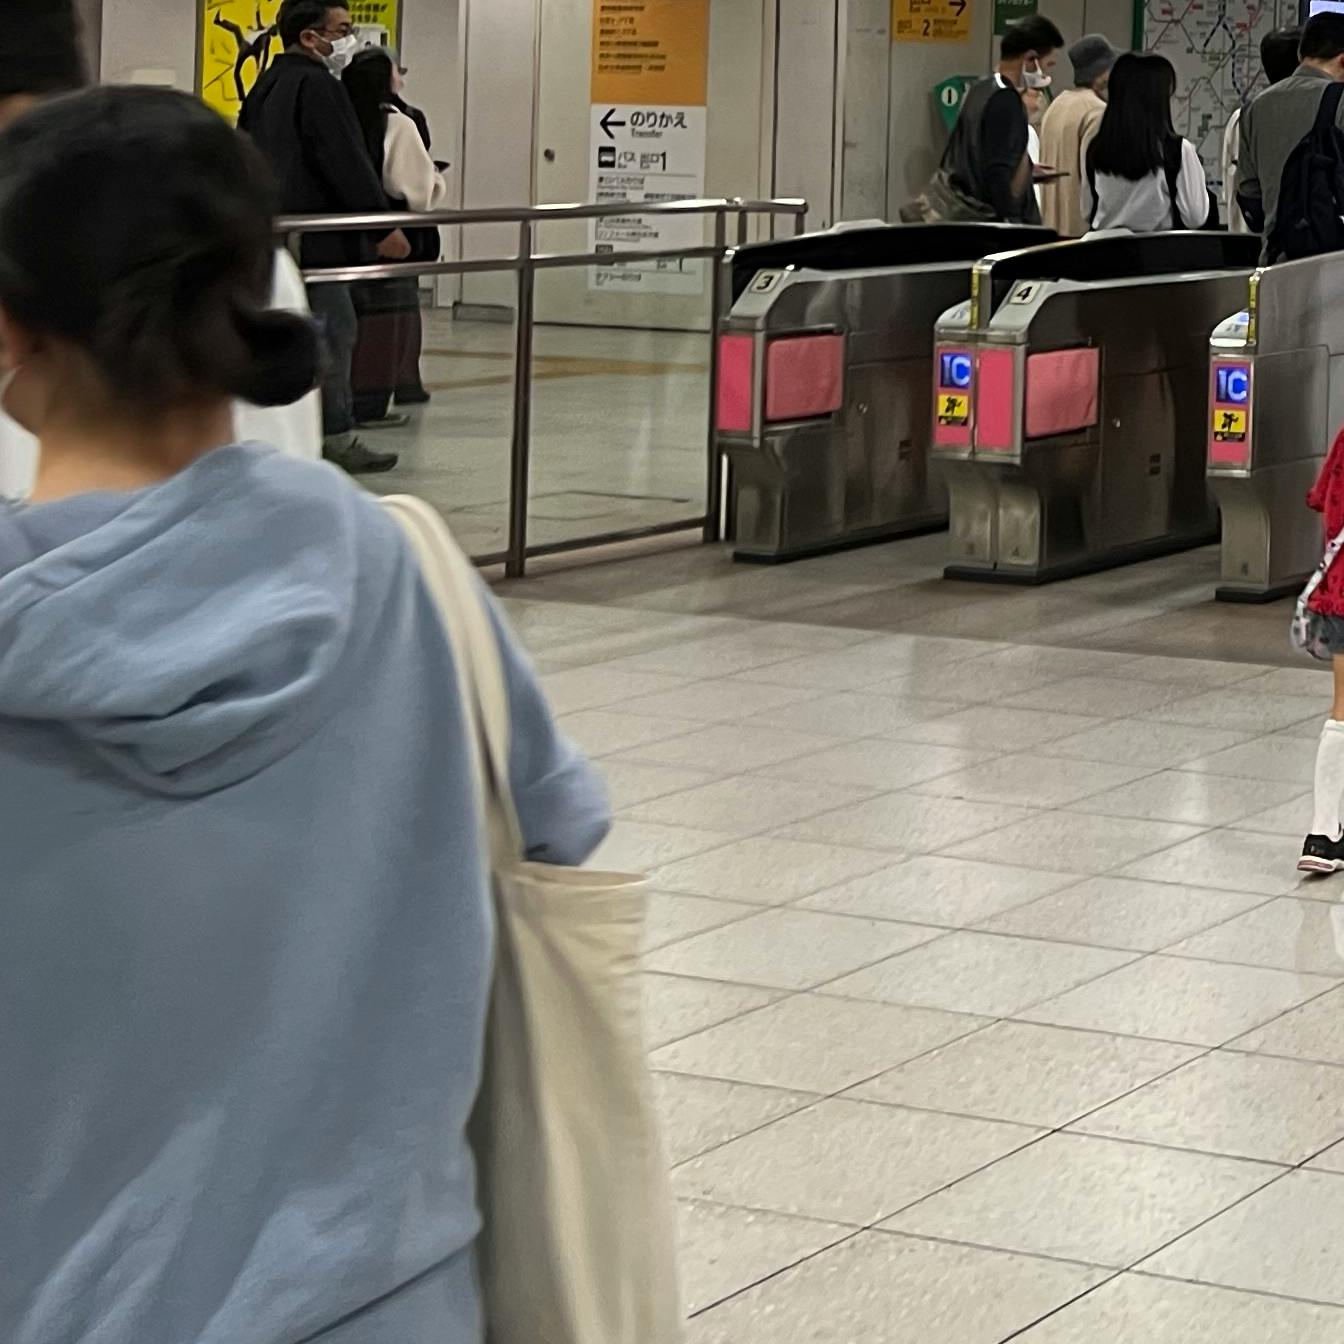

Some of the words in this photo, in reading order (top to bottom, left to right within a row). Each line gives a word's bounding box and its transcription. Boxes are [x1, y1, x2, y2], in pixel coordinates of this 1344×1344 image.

[922, 18, 931, 37] 2
[630, 110, 688, 129] のりかえ
[618, 151, 636, 162] バス
[660, 151, 667, 172] 1
[756, 275, 775, 291] 3
[1016, 285, 1033, 301] 4
[942, 354, 971, 387] IC
[1218, 369, 1248, 401] IC
